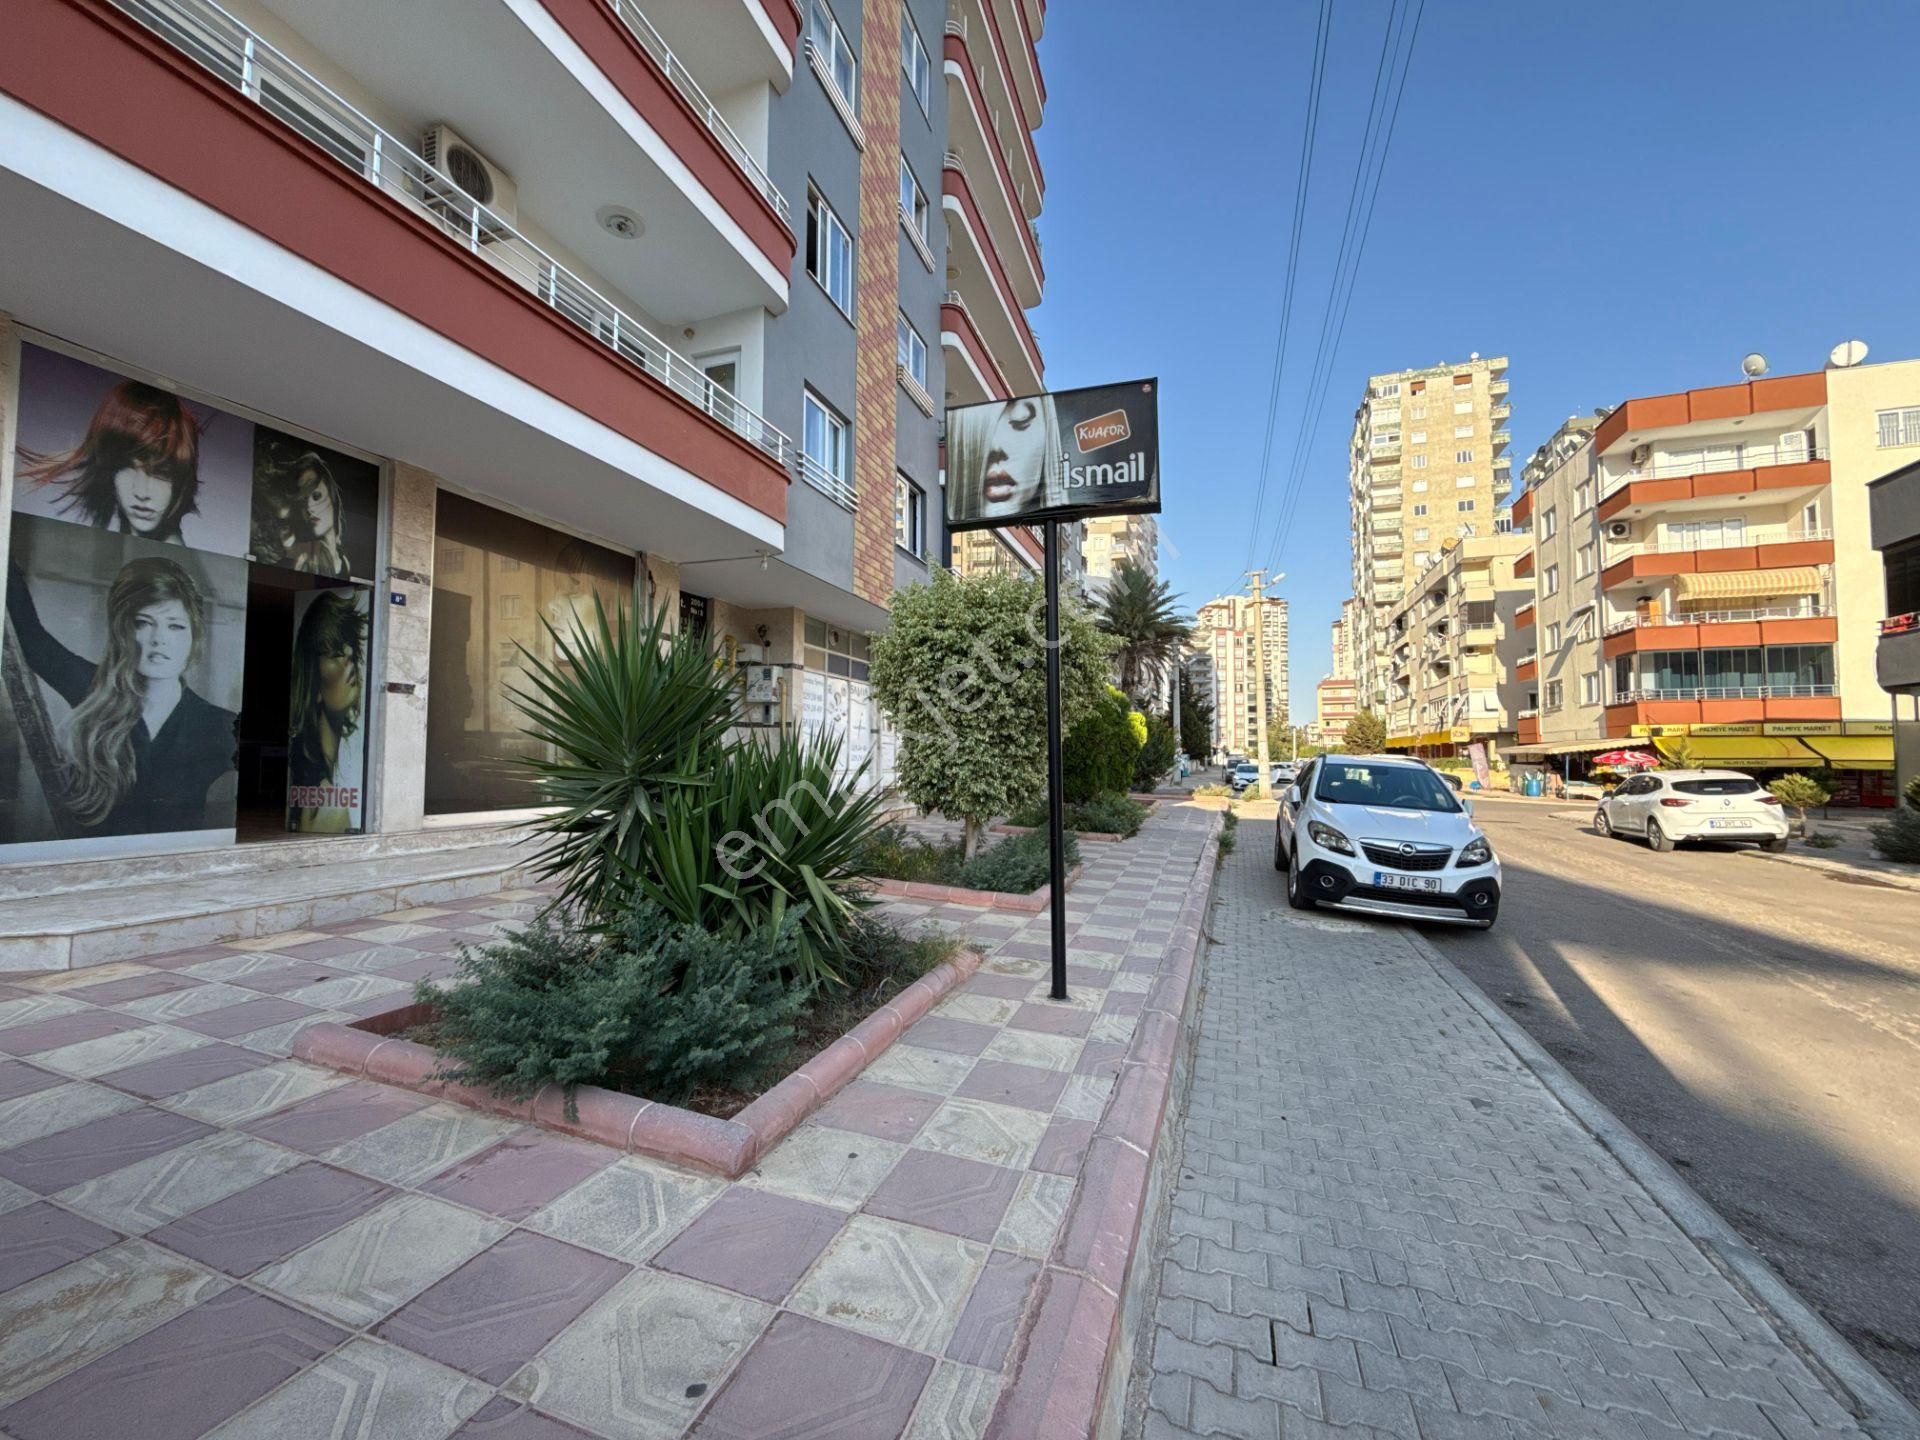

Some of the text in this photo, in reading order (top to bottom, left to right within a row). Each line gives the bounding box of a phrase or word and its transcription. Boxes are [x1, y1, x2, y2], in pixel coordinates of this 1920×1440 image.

[1061, 452, 1145, 489] ismail
[1381, 874, 1394, 885] 33
[1424, 879, 1437, 890] 90
